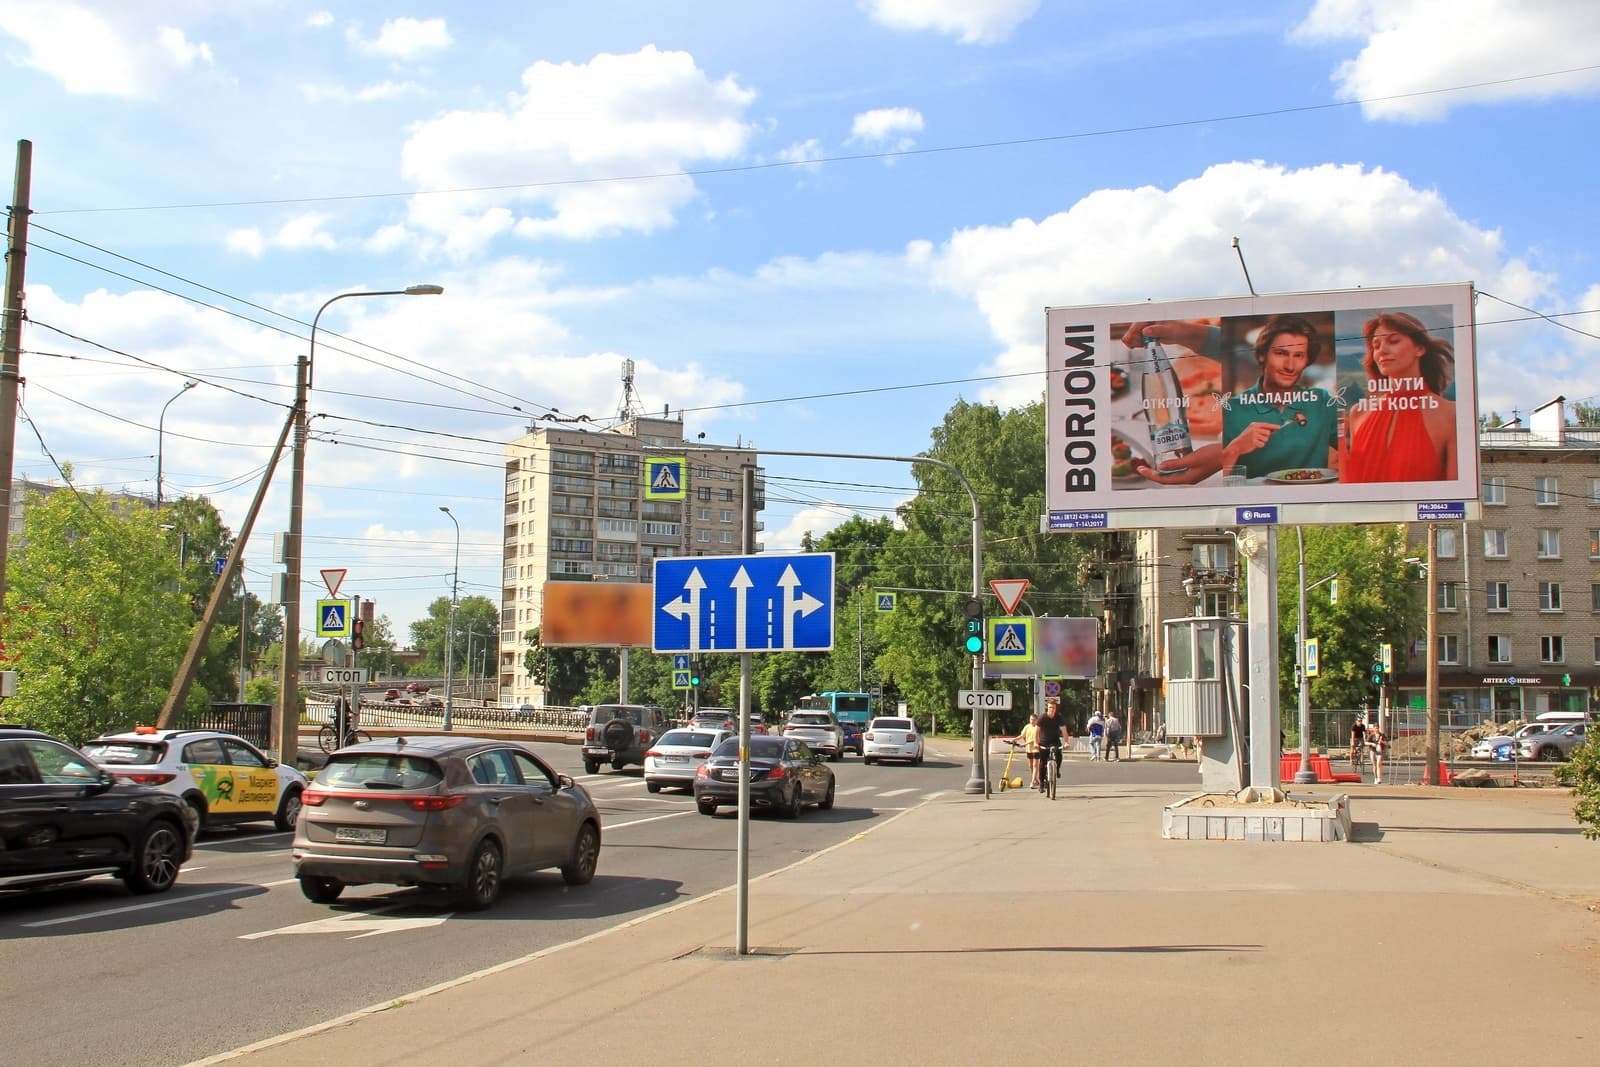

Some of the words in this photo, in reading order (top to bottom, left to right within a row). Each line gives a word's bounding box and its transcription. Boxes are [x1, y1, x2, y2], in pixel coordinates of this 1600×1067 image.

[1367, 376, 1424, 394] ОЩУТИ
[1142, 394, 1191, 409] ОТКРОЙ
[1239, 391, 1318, 405] НАСЛАДИСЬ
[1357, 395, 1439, 412] ЛЁГКОСТЬ
[1064, 324, 1097, 493] BORJOMI
[1253, 511, 1271, 519] Russ
[968, 621, 980, 632] 31
[326, 670, 360, 683] СТОП
[966, 693, 1004, 706] СТОП
[249, 776, 277, 791] Маркет
